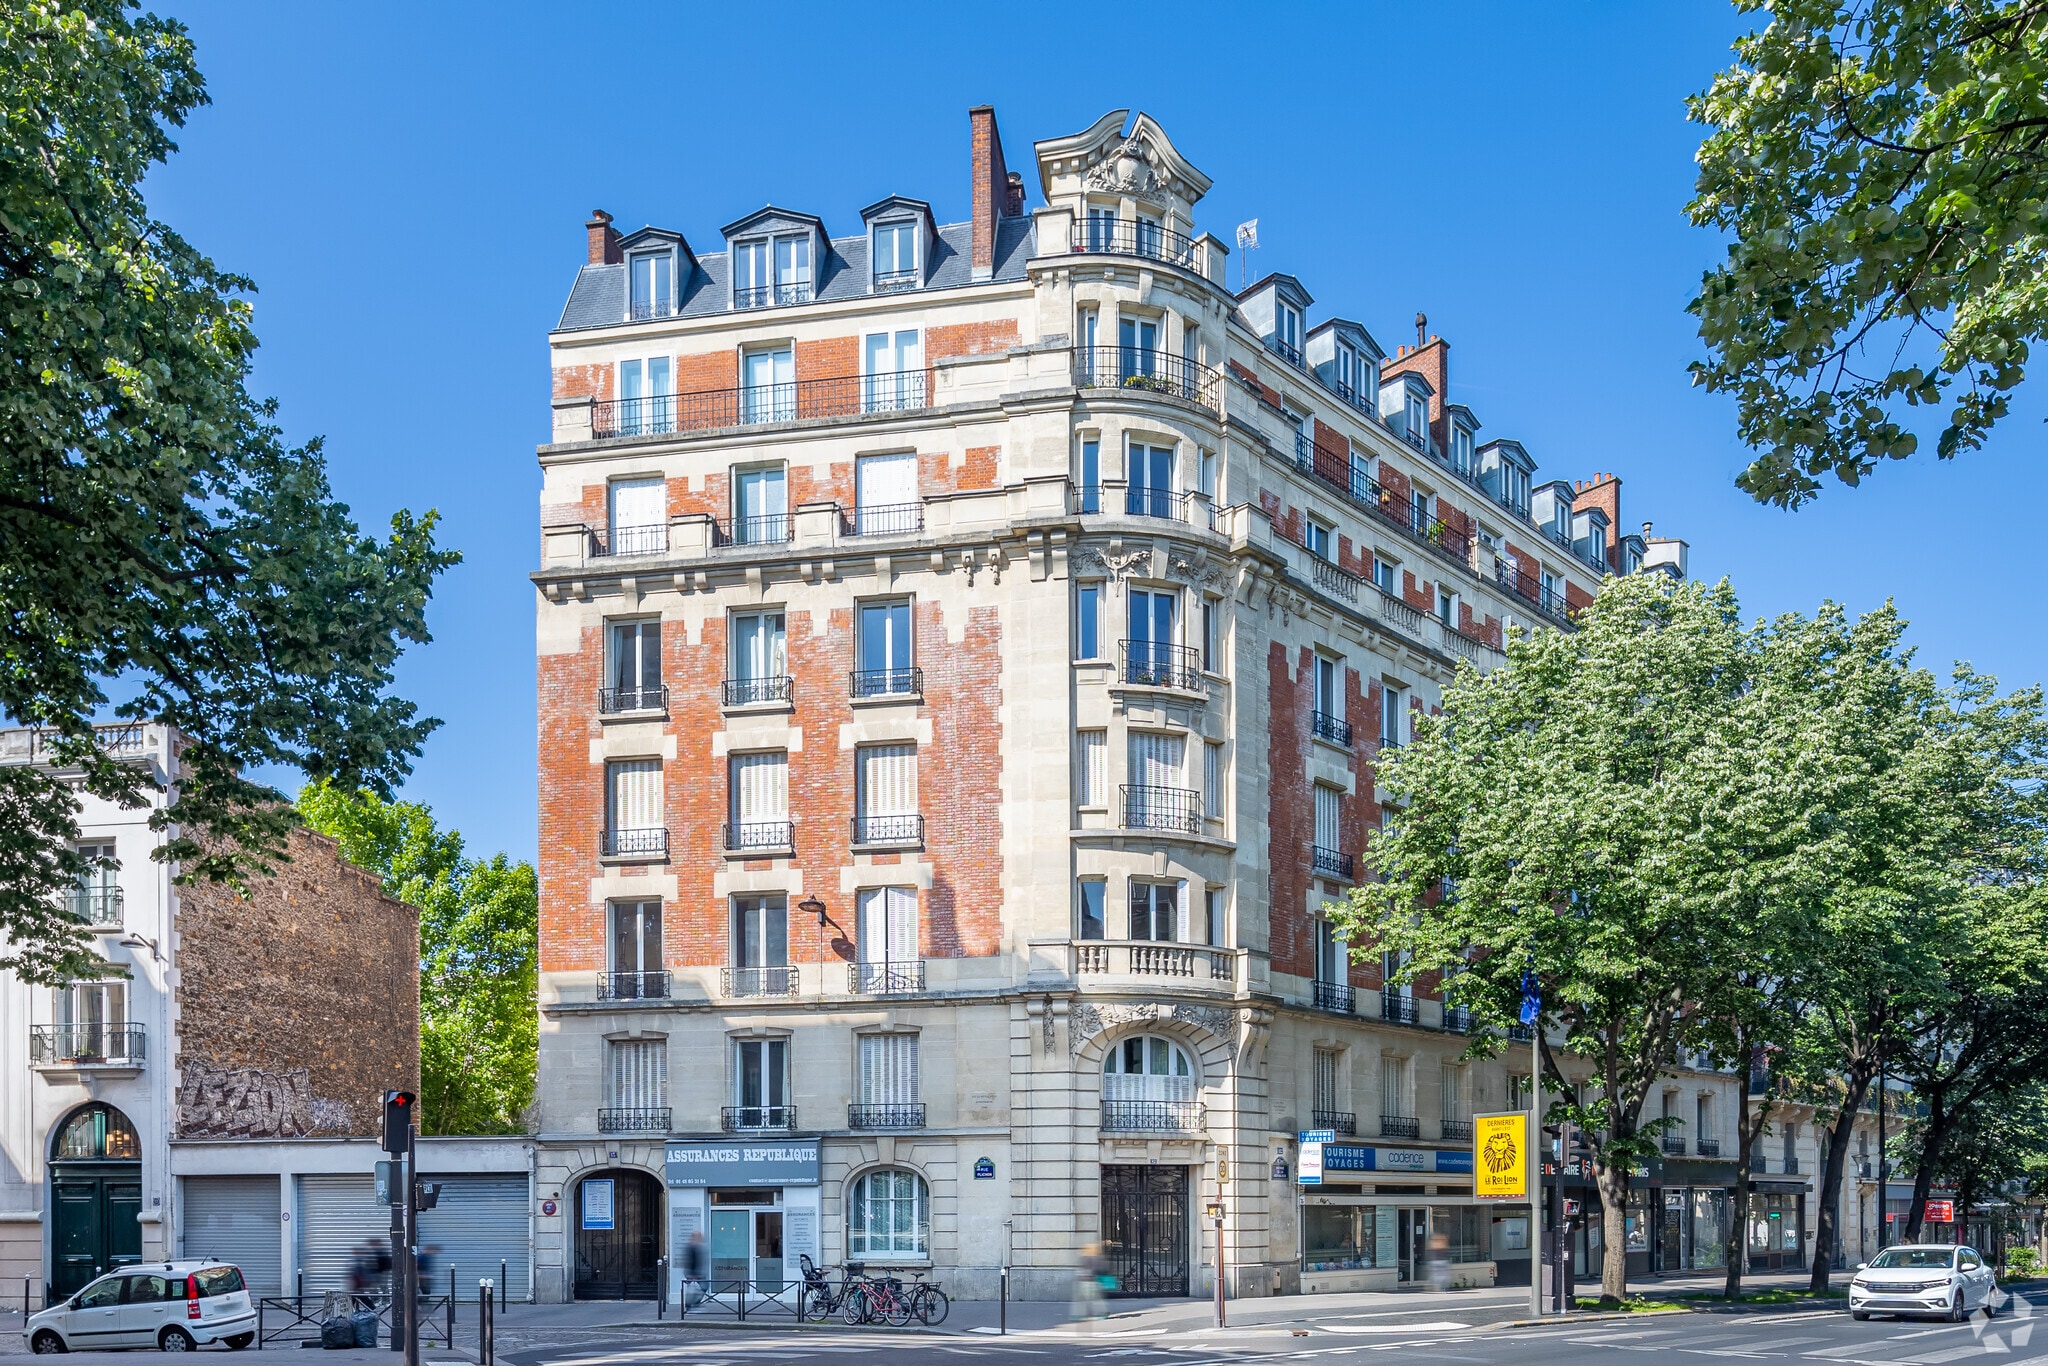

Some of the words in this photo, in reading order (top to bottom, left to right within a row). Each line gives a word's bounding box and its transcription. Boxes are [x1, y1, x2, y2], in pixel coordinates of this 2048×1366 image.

[667, 1149, 740, 1162] ASSURANCES
[743, 1148, 817, 1163] REPUBLIQUE
[1388, 1150, 1424, 1164] cadence
